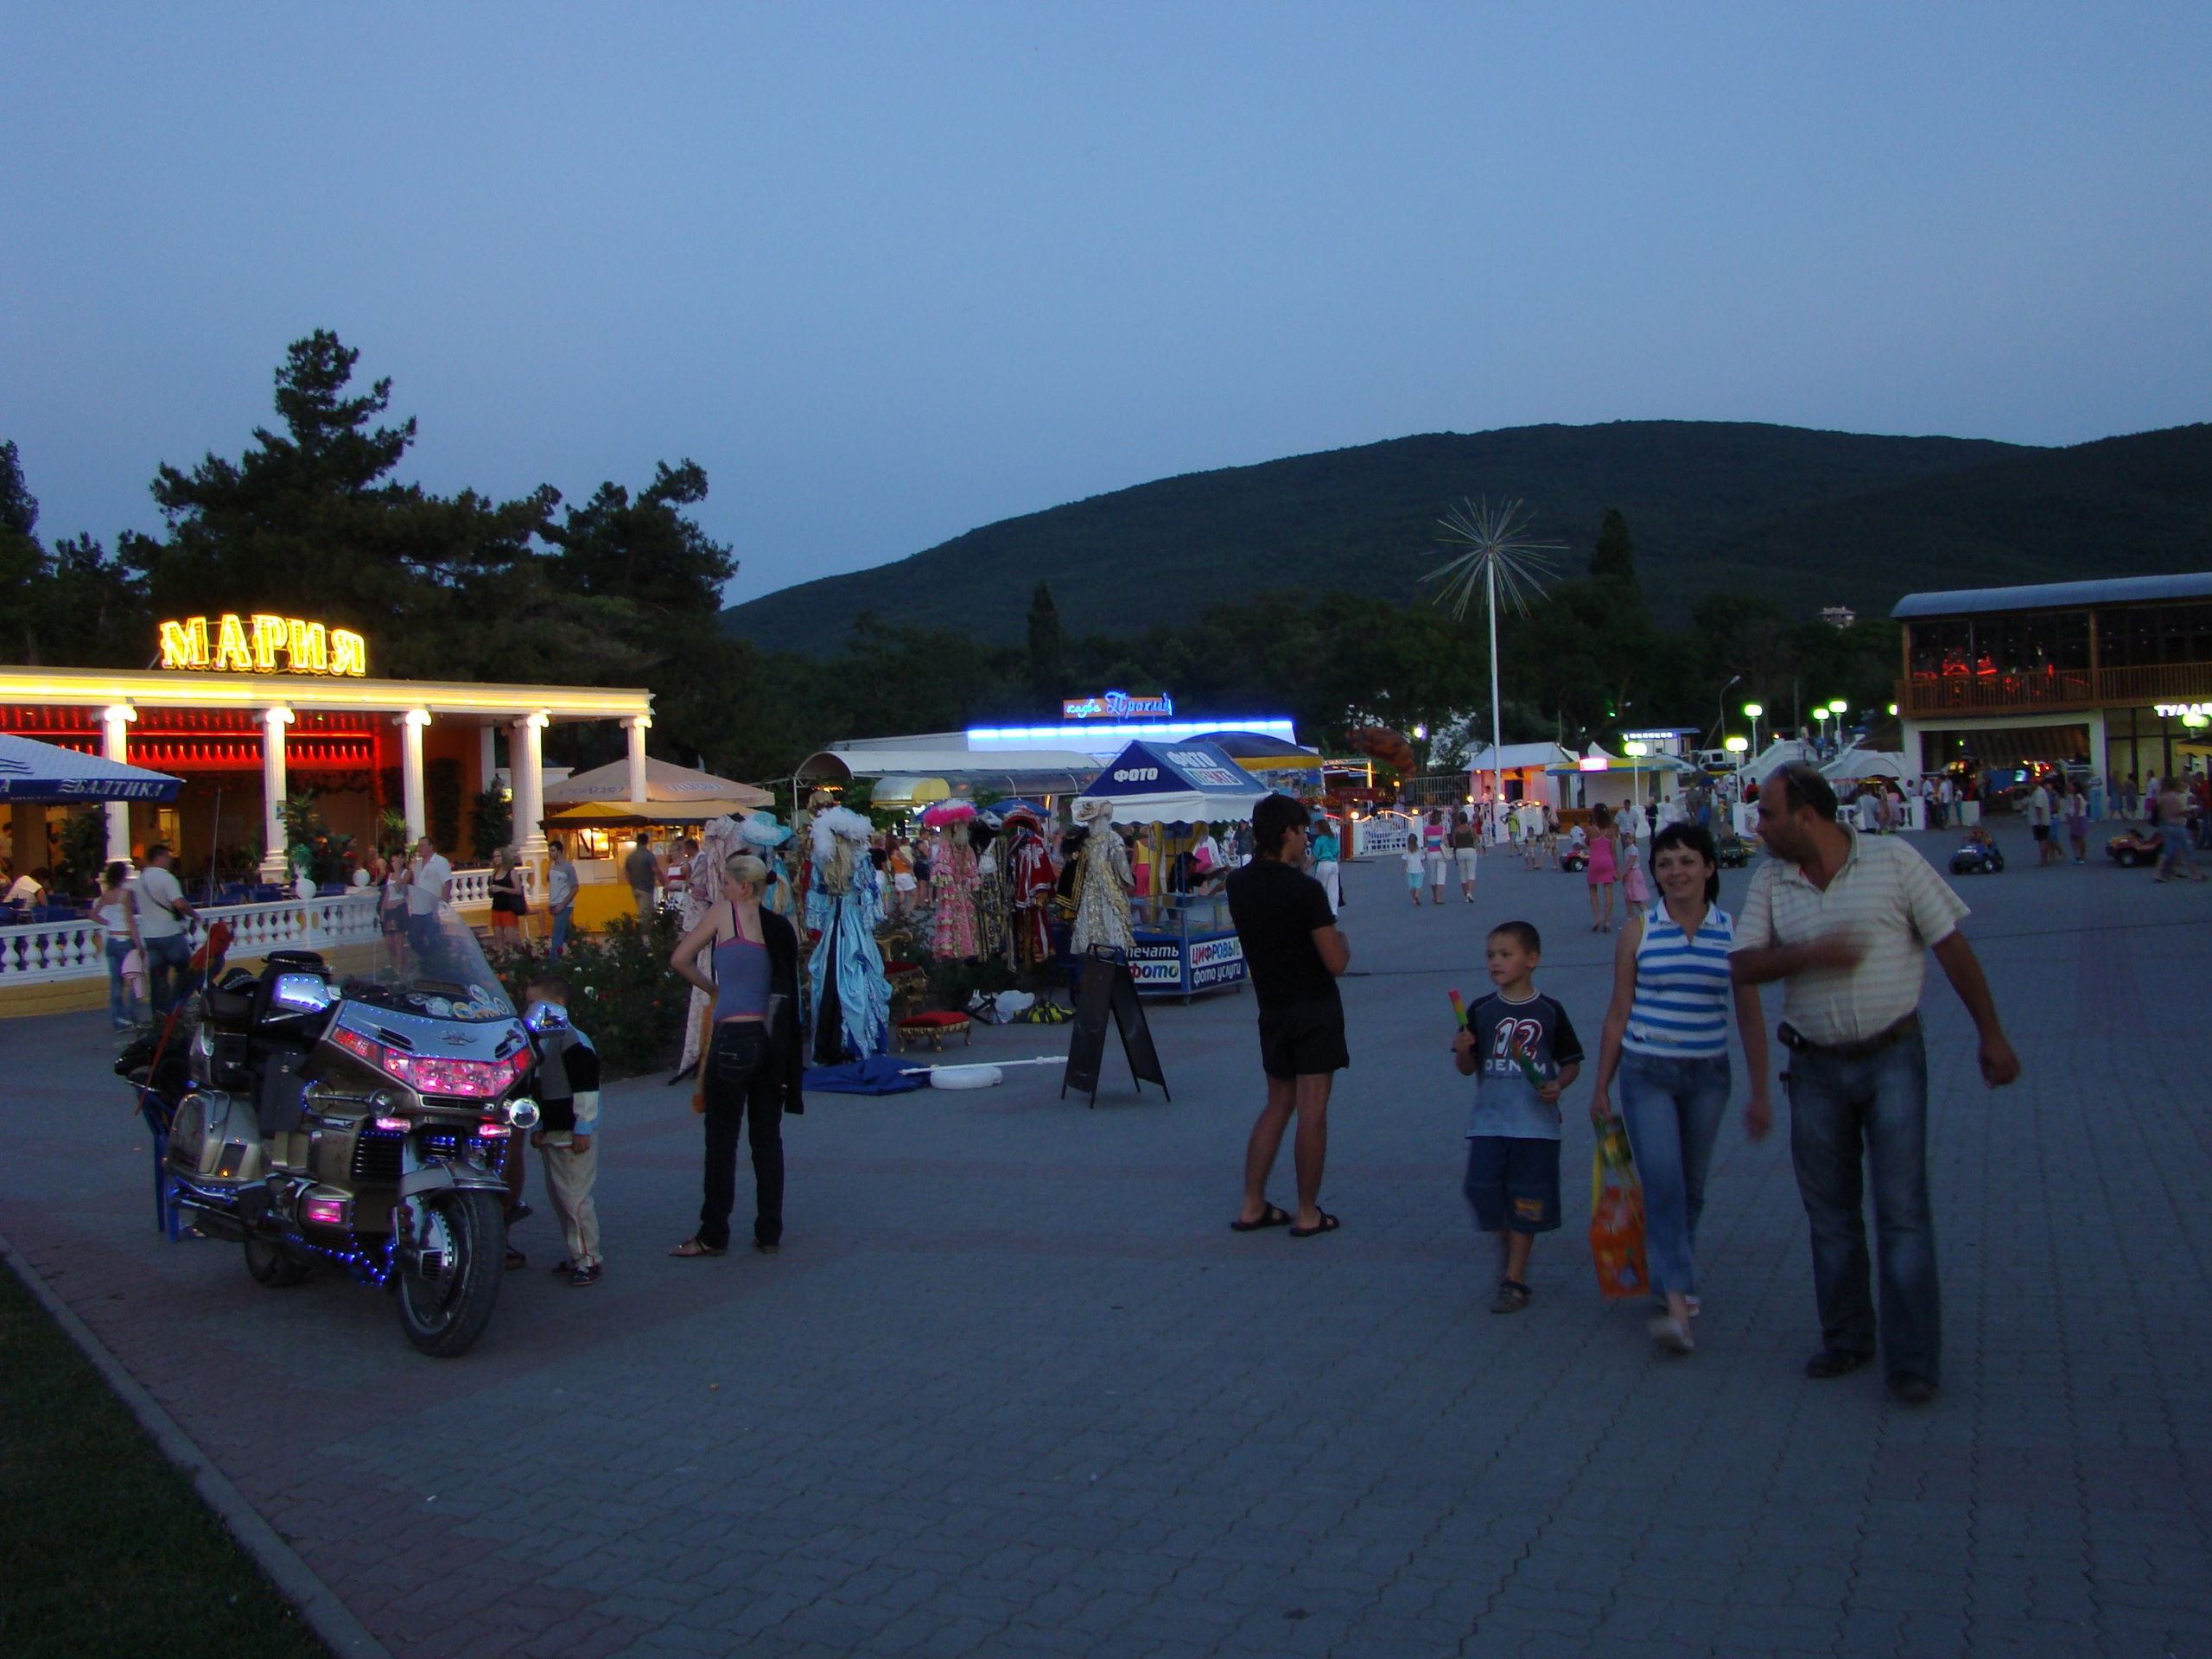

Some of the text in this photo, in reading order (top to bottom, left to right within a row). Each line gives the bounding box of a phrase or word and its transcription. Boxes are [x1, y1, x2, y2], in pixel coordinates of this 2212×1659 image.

[160, 613, 366, 677] МАРИЯ
[1114, 767, 1159, 782] ФОТО
[73, 779, 165, 797] БАЛТИКА
[1193, 962, 1242, 987] фото услуги
[1484, 1058, 1547, 1075] DENM
